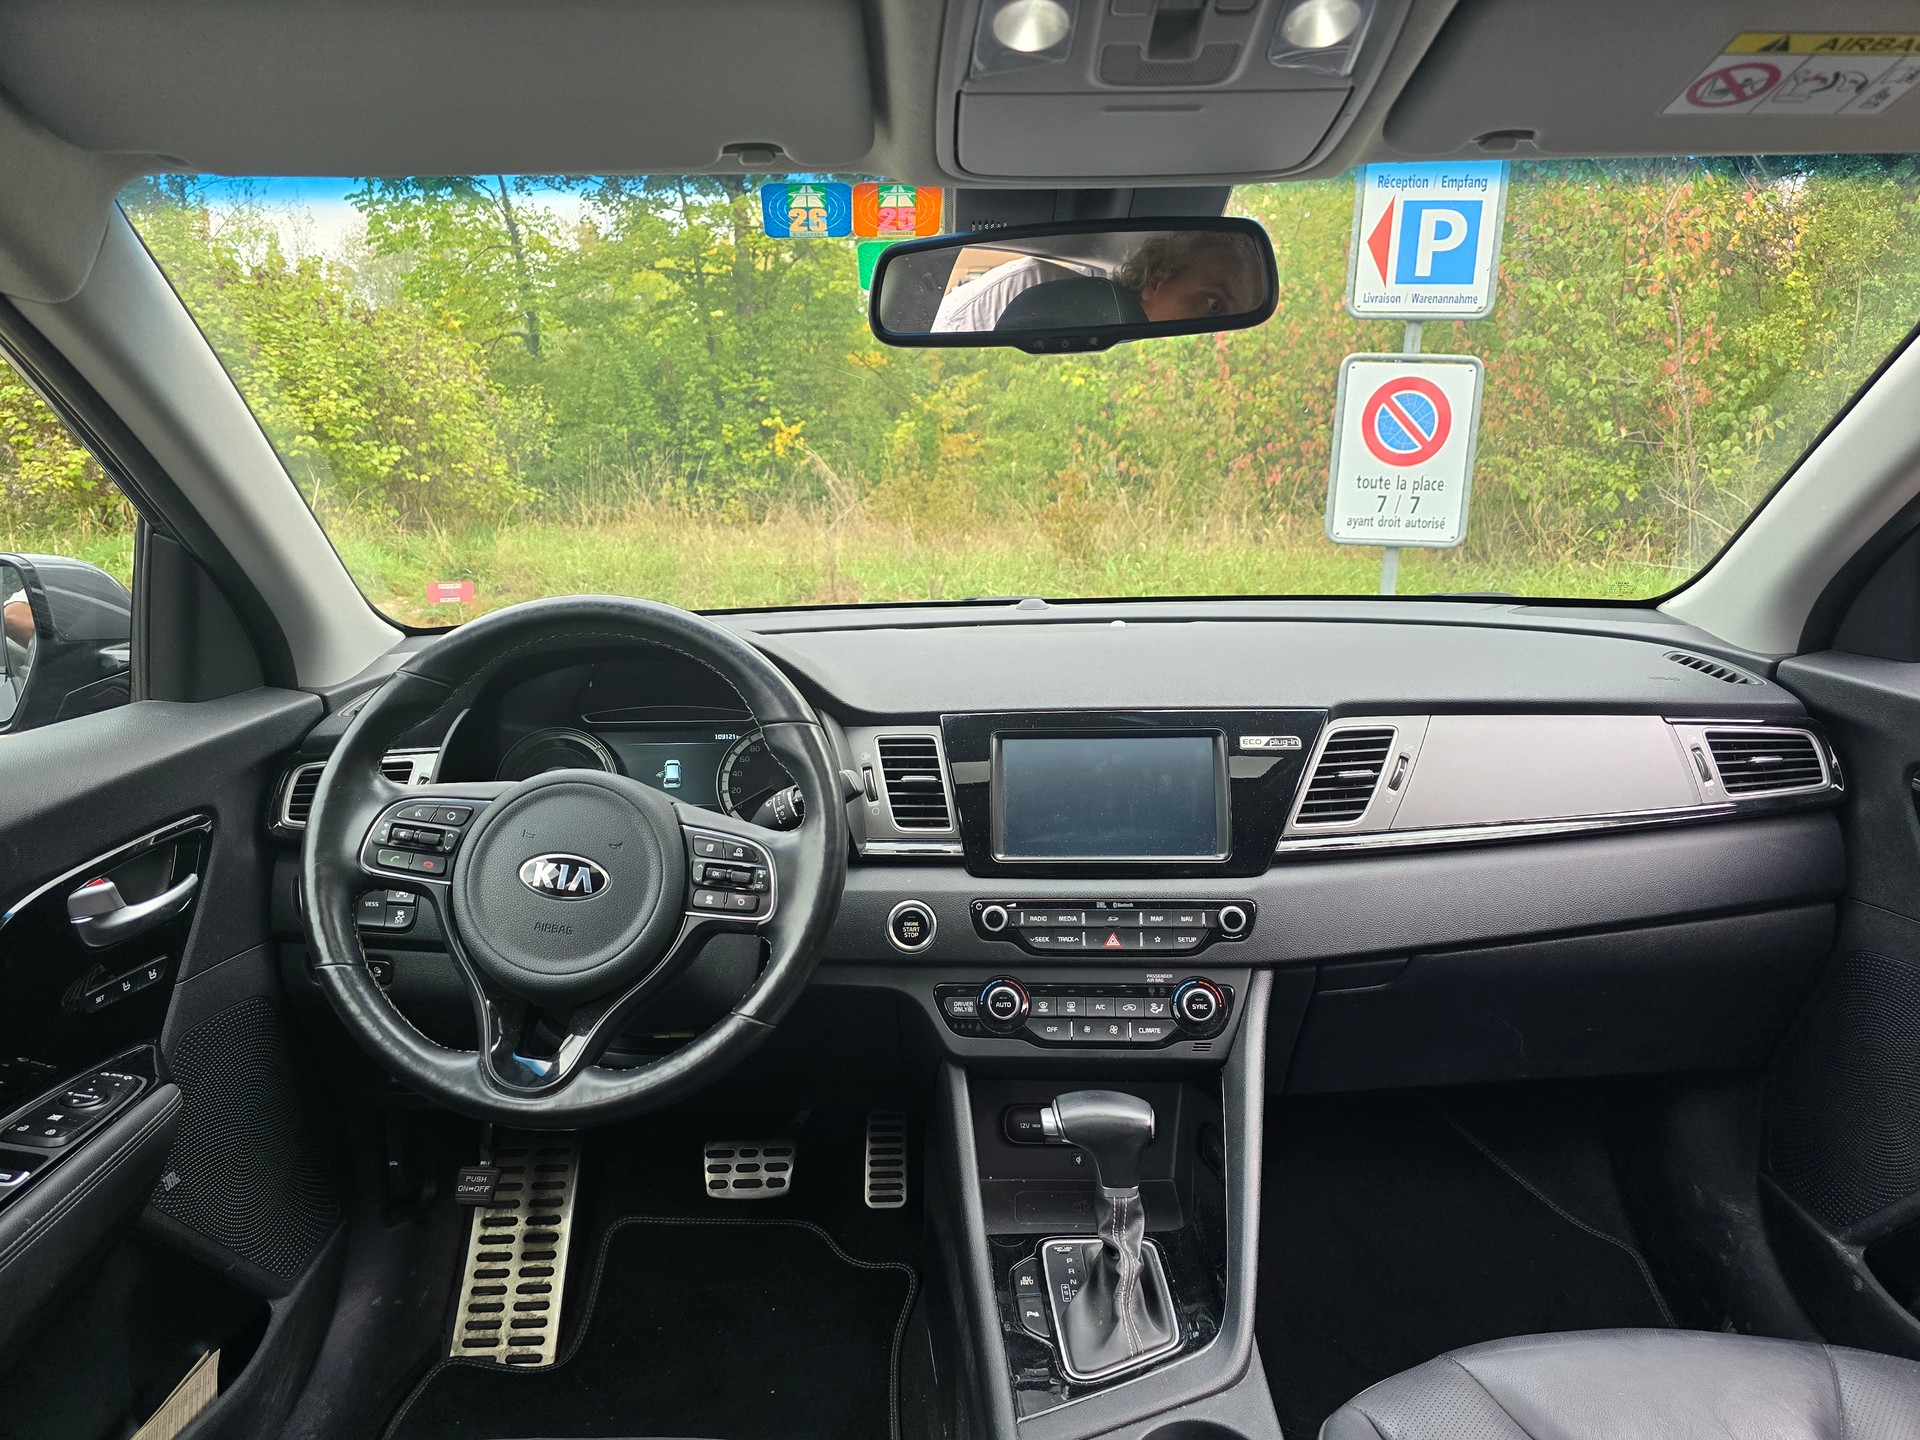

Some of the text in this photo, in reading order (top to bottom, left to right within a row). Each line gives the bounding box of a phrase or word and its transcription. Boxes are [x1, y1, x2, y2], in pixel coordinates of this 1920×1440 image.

[1815, 38, 1920, 51] AIRBA
[1377, 173, 1429, 191] Réception
[1441, 175, 1488, 192] Empfang
[1414, 208, 1468, 277] P
[1363, 292, 1401, 303] Livraison
[1411, 293, 1478, 304] Warenannahme
[1356, 475, 1445, 494] toute la place
[1377, 495, 1387, 513] 7
[1410, 496, 1420, 514] 7
[1346, 515, 1446, 529] ayant droit autorisé
[1269, 738, 1299, 747] plug-in
[532, 861, 593, 893] KIA
[533, 921, 573, 935] AIRBAG
[95, 994, 105, 1004] SET
[465, 1175, 487, 1183] PUSH
